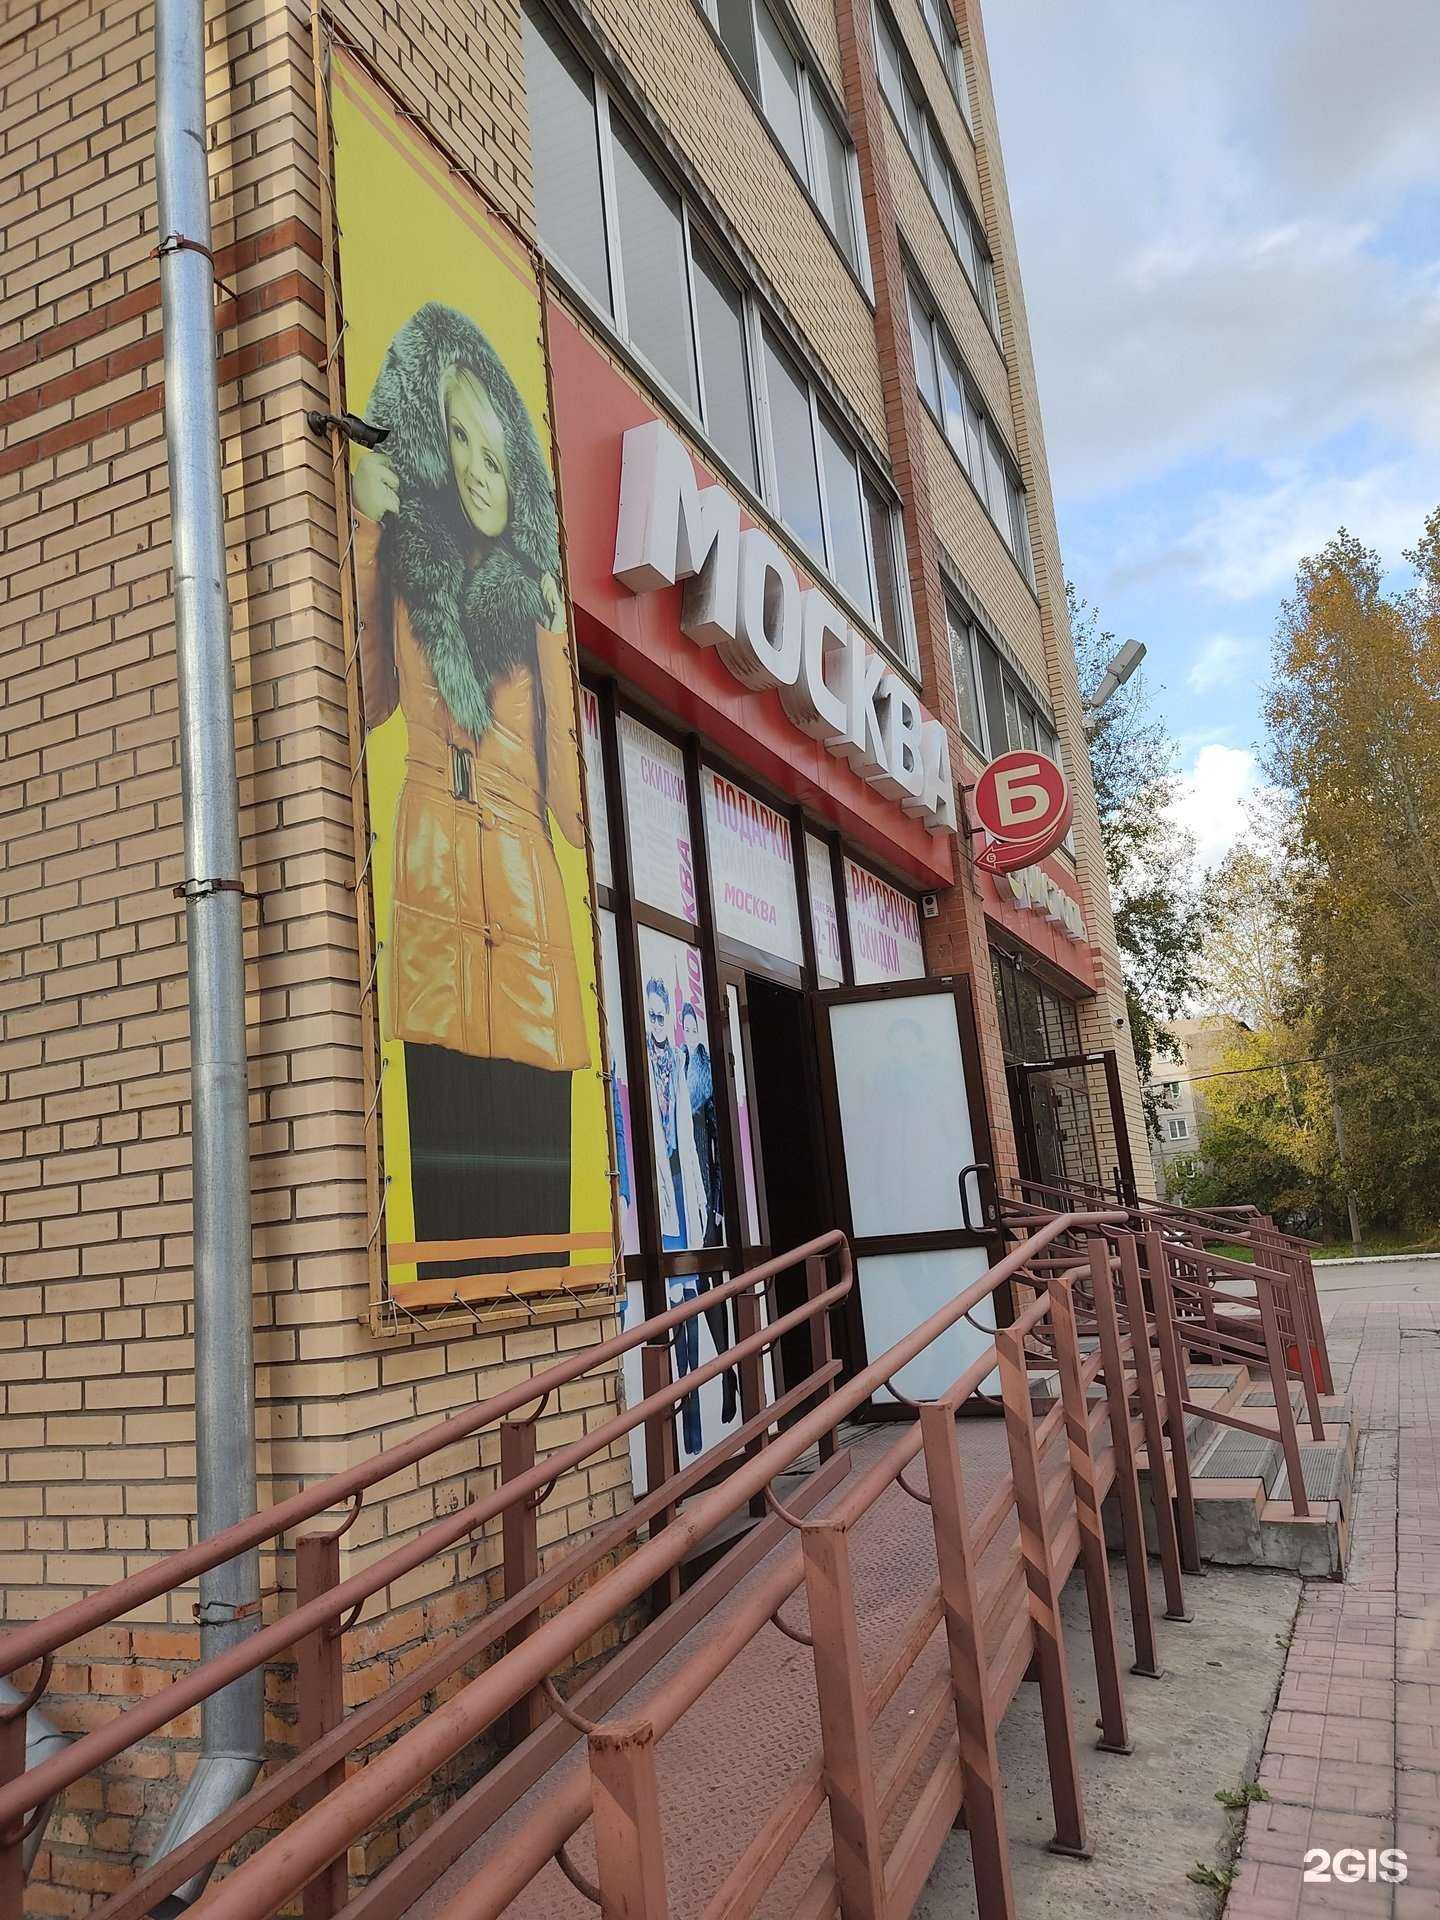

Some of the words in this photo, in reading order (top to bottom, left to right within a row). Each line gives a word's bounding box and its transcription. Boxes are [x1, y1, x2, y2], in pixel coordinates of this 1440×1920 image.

[613, 419, 957, 834] МОСКВА
[641, 755, 686, 806] СКИДКИ
[994, 763, 1051, 827] Б
[713, 775, 792, 864] ПОДАРКИ
[724, 883, 777, 926] МОСКВА
[850, 864, 920, 946] РАССРОЧКА
[857, 921, 902, 976] СКИДКИ
